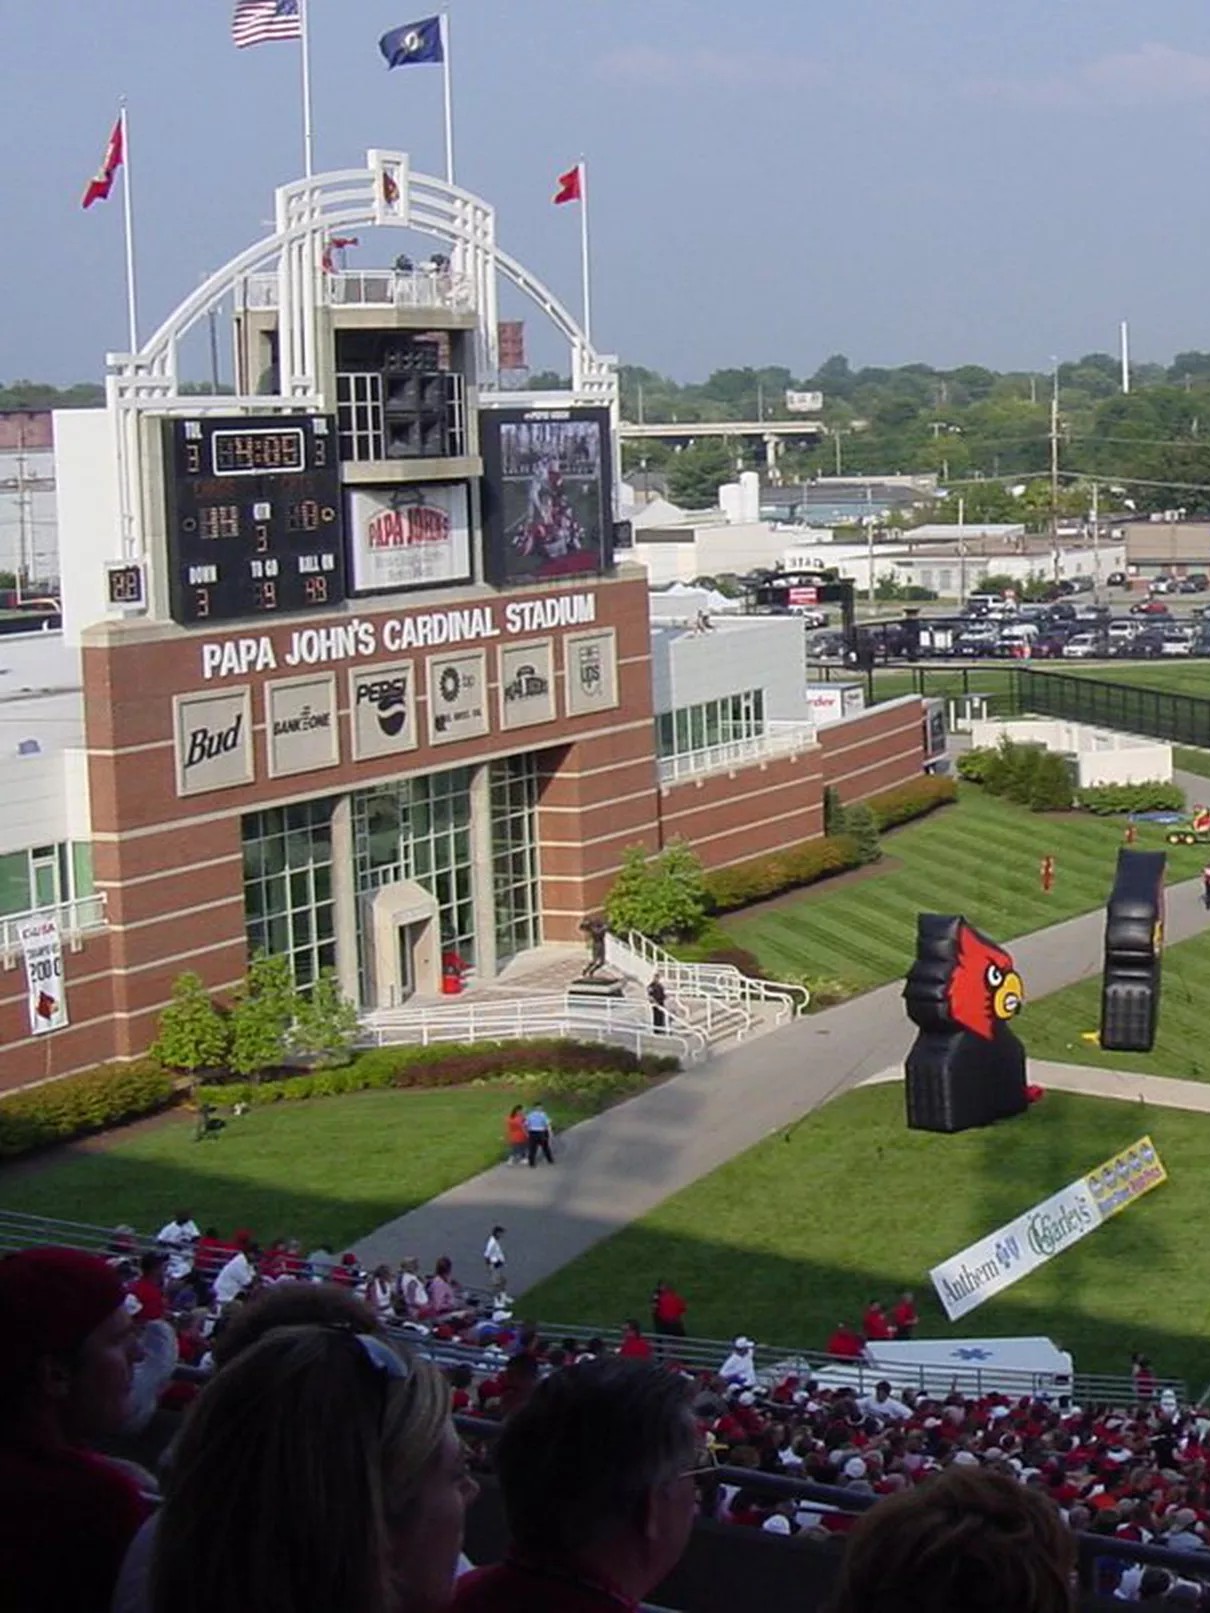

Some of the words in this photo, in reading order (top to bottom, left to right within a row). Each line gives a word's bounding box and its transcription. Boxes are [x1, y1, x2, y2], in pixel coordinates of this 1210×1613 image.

[369, 510, 404, 546] PAPA
[203, 637, 277, 679] PAPA
[286, 619, 376, 665] JOHN'S
[383, 607, 499, 651] CARDINAL
[506, 593, 595, 633] STADIUM
[185, 713, 242, 769] Bud
[941, 1258, 1000, 1302] Anthem
